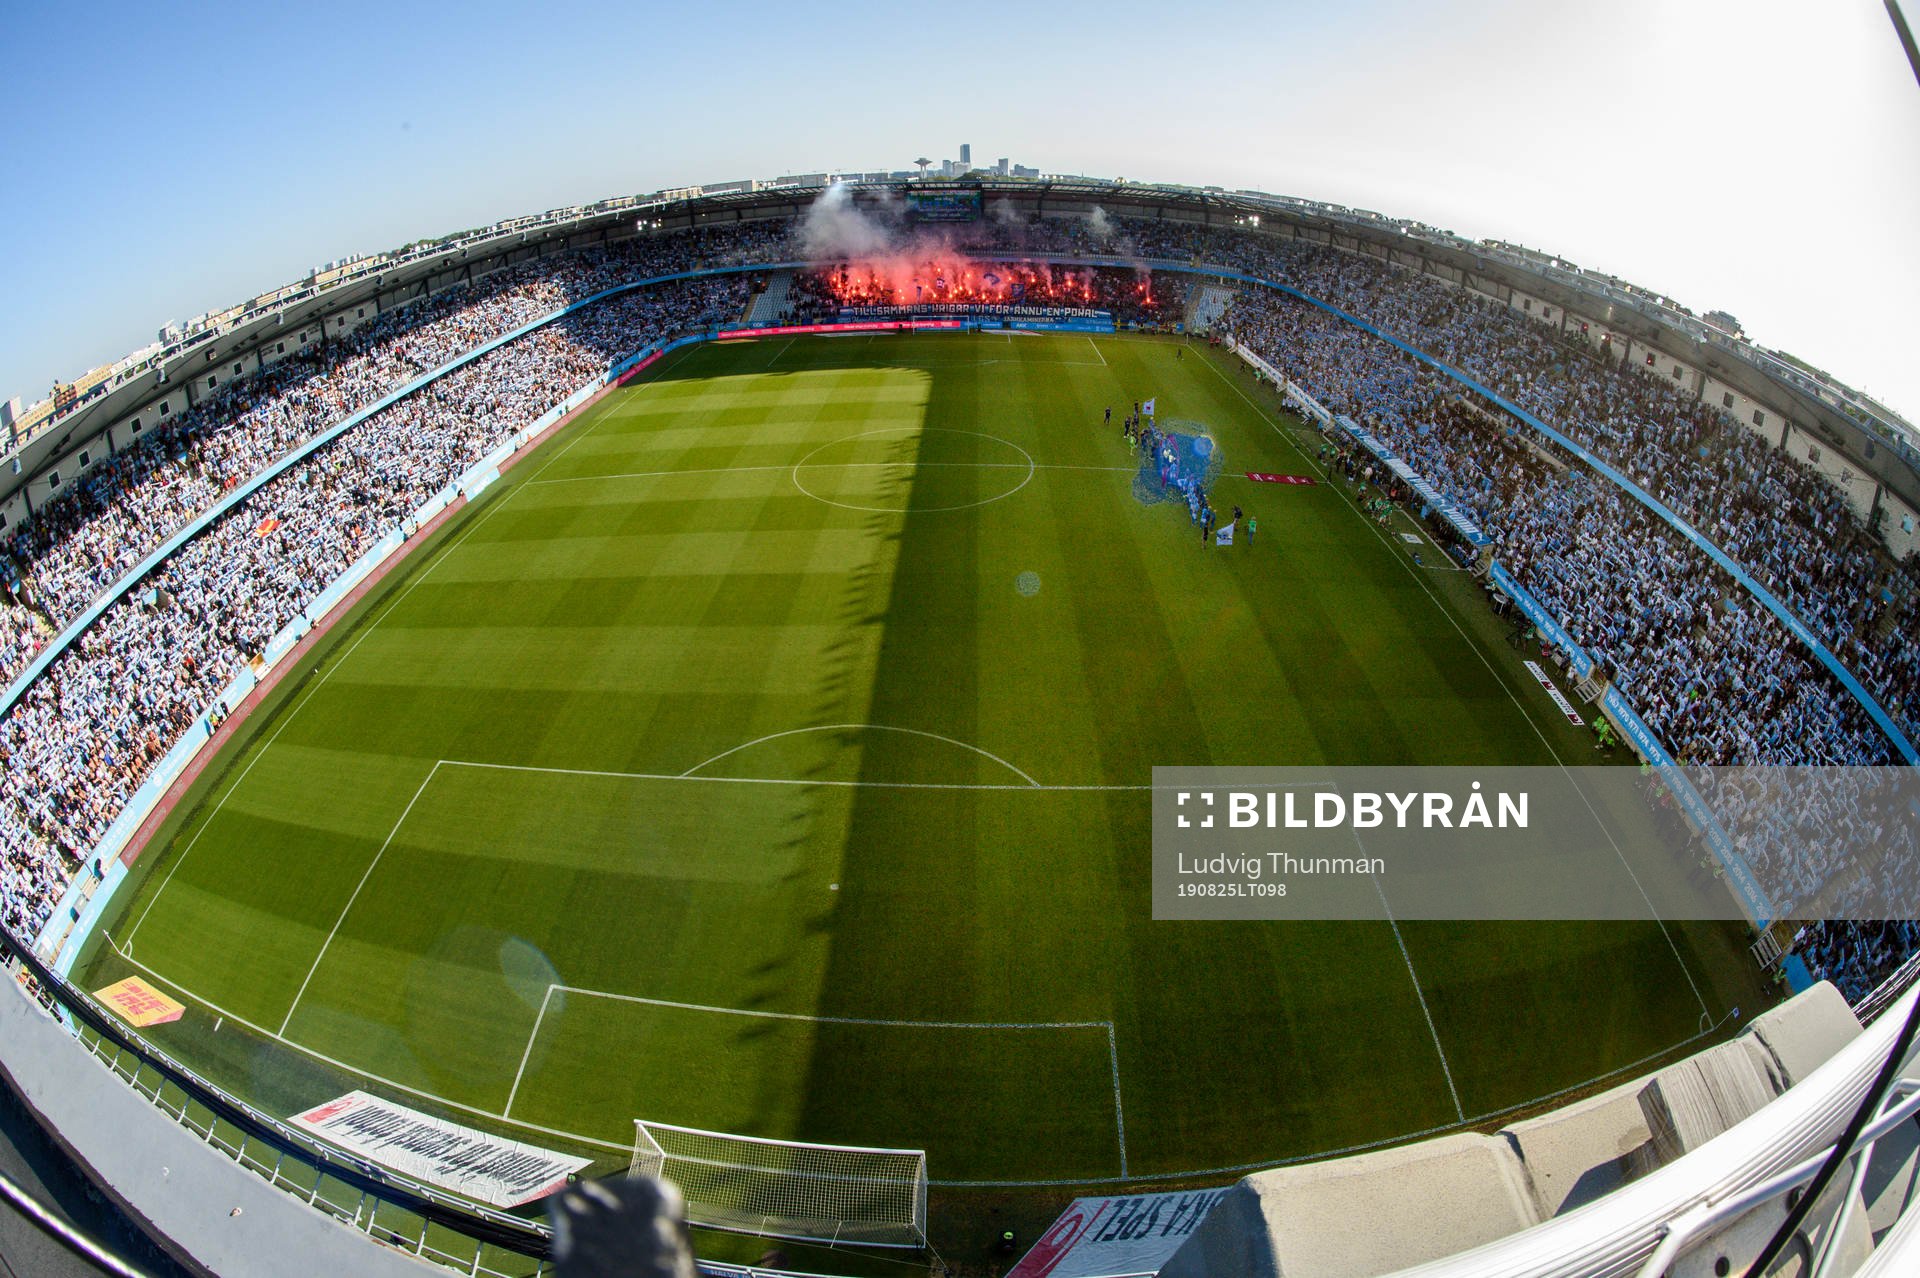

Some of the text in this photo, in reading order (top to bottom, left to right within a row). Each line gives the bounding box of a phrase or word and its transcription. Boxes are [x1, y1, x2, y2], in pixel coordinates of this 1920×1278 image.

[853, 304, 928, 316] TILLSAMMANS
[974, 304, 985, 313] VI
[1046, 307, 1060, 316] EN
[1092, 1195, 1176, 1242] SPEL
